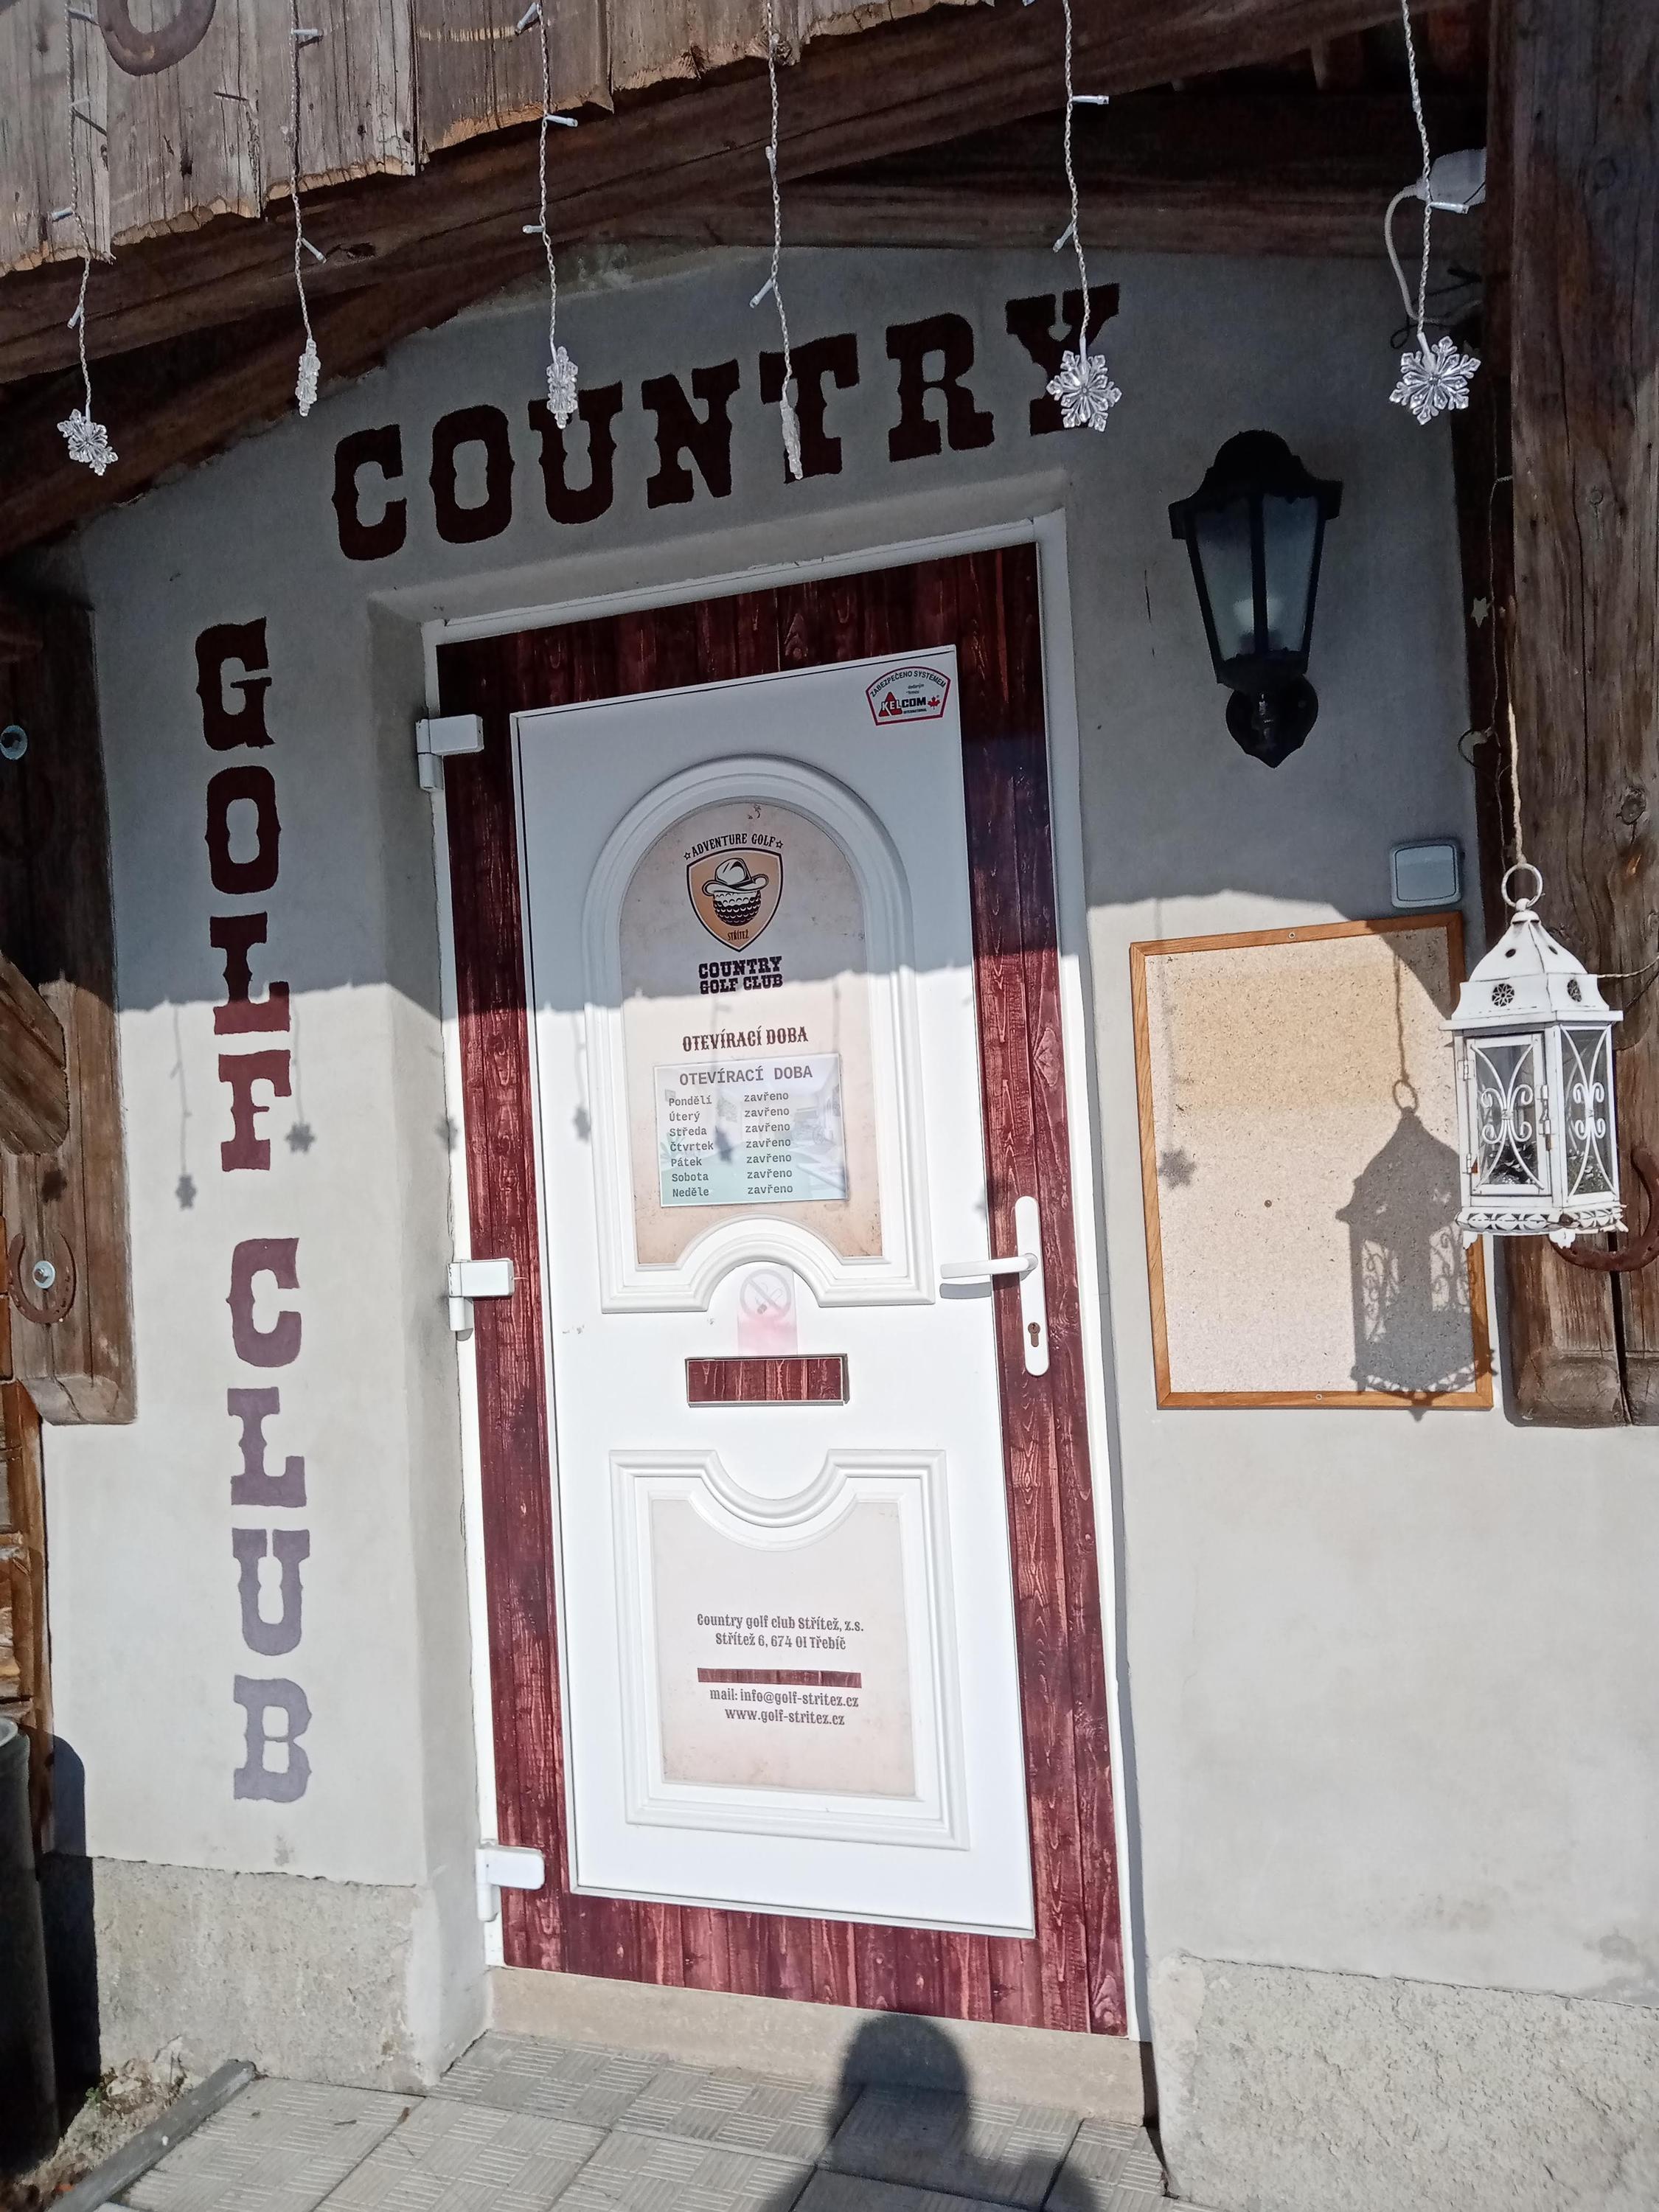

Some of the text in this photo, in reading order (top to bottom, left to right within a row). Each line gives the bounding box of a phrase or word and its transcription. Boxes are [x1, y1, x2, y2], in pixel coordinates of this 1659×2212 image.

[330, 283, 1121, 562] COUNTRY
[870, 670, 913, 698] ZABEZPEČENO
[691, 832, 776, 858] ADVENTURE GOLF
[698, 956, 782, 979] COUNTRY
[700, 973, 783, 995] GOLF CLUB
[682, 1026, 809, 1052] OTEVÍRACÍ DOBA
[679, 1065, 813, 1086] OTEVÍRACÍ DOBA
[669, 1092, 789, 1107] Pondělí zavřeno
[669, 1107, 790, 1123] Úterý zavřeno
[669, 1122, 790, 1137] Středa zavřeno
[669, 1138, 791, 1152] Čtvrtek zavřeno
[671, 1154, 792, 1167] Pátek zavřeno
[672, 1169, 793, 1183] Sobota zavřeno
[672, 1184, 793, 1197] Neděle zavřeno
[195, 616, 313, 1804] GOLF CLUB
[697, 1613, 864, 1632] Country golf club Střítež, z.s.
[715, 1632, 756, 1646] Střítež
[758, 1635, 768, 1648] 6,
[771, 1635, 793, 1647] 674
[810, 1636, 846, 1650] Třebíč
[709, 1688, 859, 1708] mail: info@golf-stritez.cz
[725, 1708, 845, 1725] www.golf-stritez.cz
